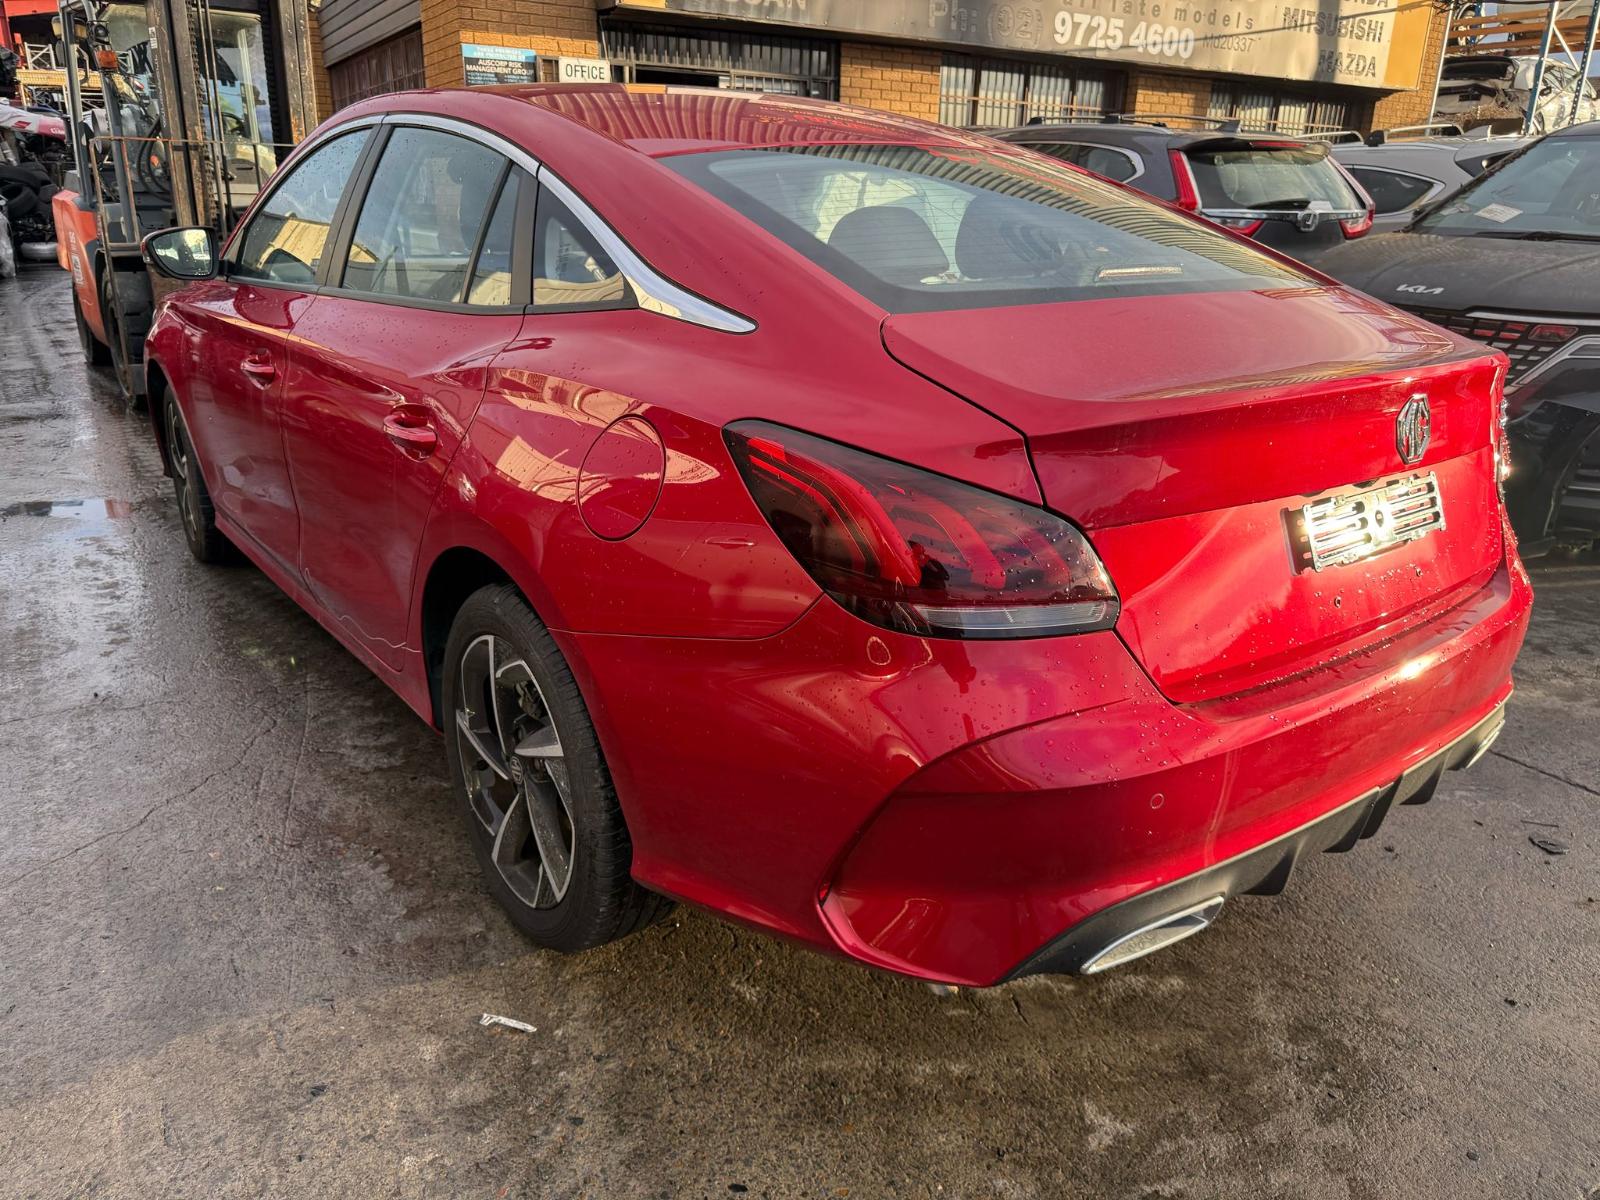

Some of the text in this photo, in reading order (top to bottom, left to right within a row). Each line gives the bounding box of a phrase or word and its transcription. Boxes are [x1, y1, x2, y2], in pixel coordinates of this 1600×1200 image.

[1111, 0, 1161, 18] late
[1174, 6, 1254, 30] models
[1283, 7, 1385, 43] MITSUBISHI
[1053, 10, 1125, 50] 9725
[1129, 21, 1195, 59] 4600
[465, 64, 512, 74] MANAGEMENT
[565, 63, 605, 80] OFFICE
[1318, 49, 1377, 78] MAZDA
